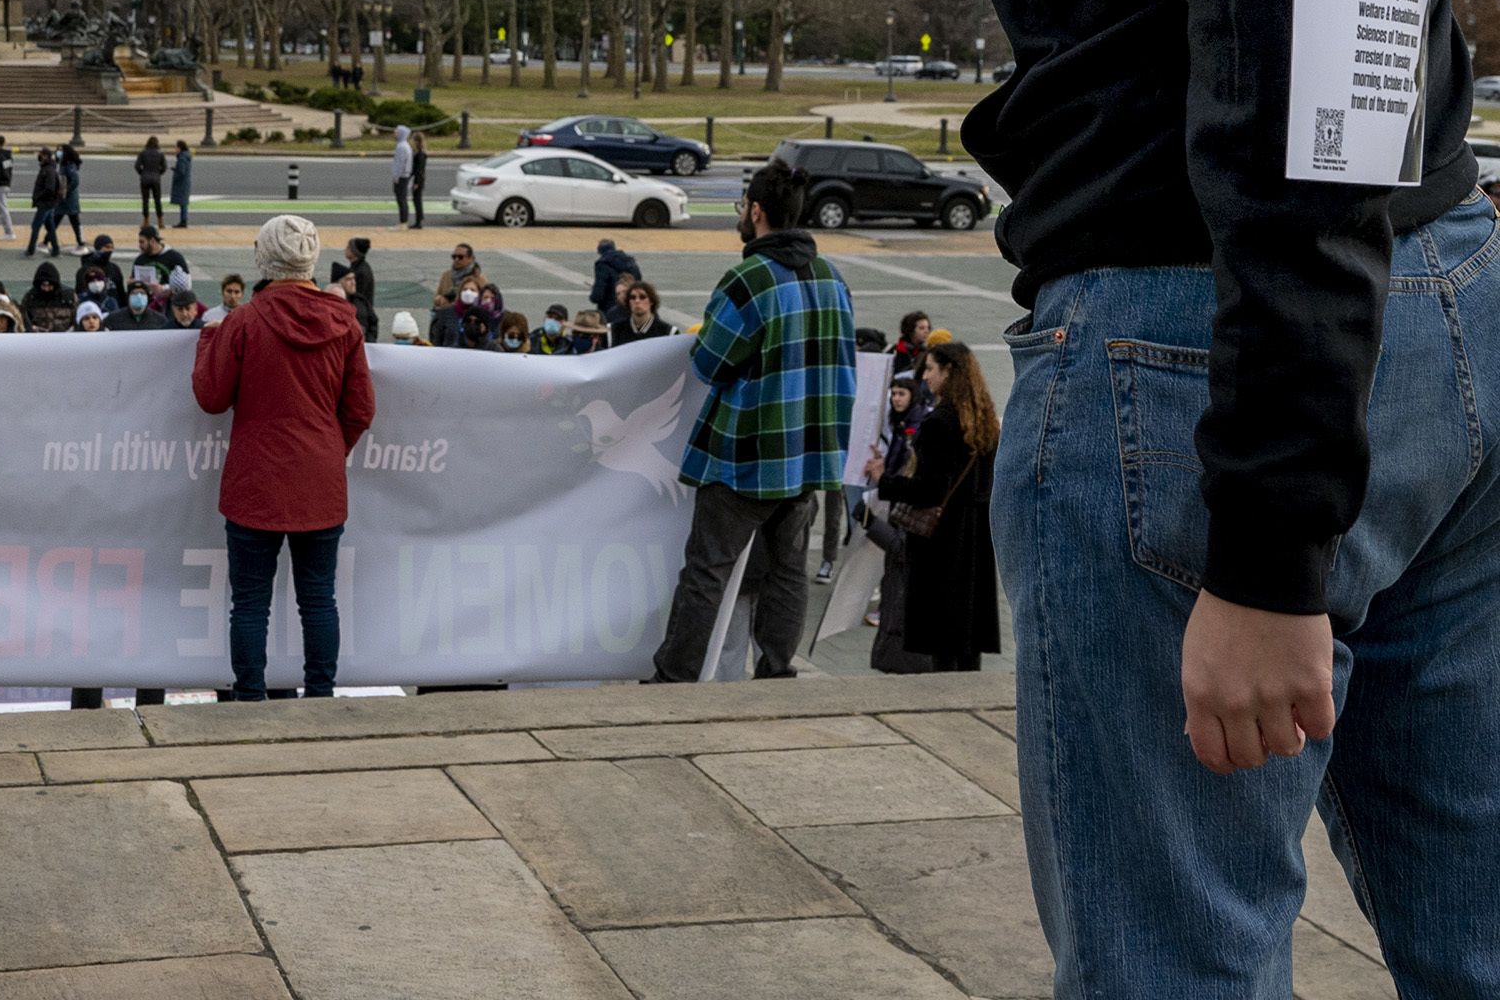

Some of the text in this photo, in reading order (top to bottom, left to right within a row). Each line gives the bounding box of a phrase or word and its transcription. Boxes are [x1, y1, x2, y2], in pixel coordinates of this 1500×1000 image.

[1359, 1, 1385, 19] Welfare
[1386, 6, 1390, 20] &
[1357, 24, 1387, 43] Sciences
[1388, 29, 1394, 44] of
[1395, 30, 1410, 47] Tehran
[1355, 49, 1411, 72] arrested on Tuesday
[1383, 74, 1403, 91] October
[1351, 93, 1368, 110] front
[1369, 96, 1376, 111] of
[1376, 97, 1386, 112] the
